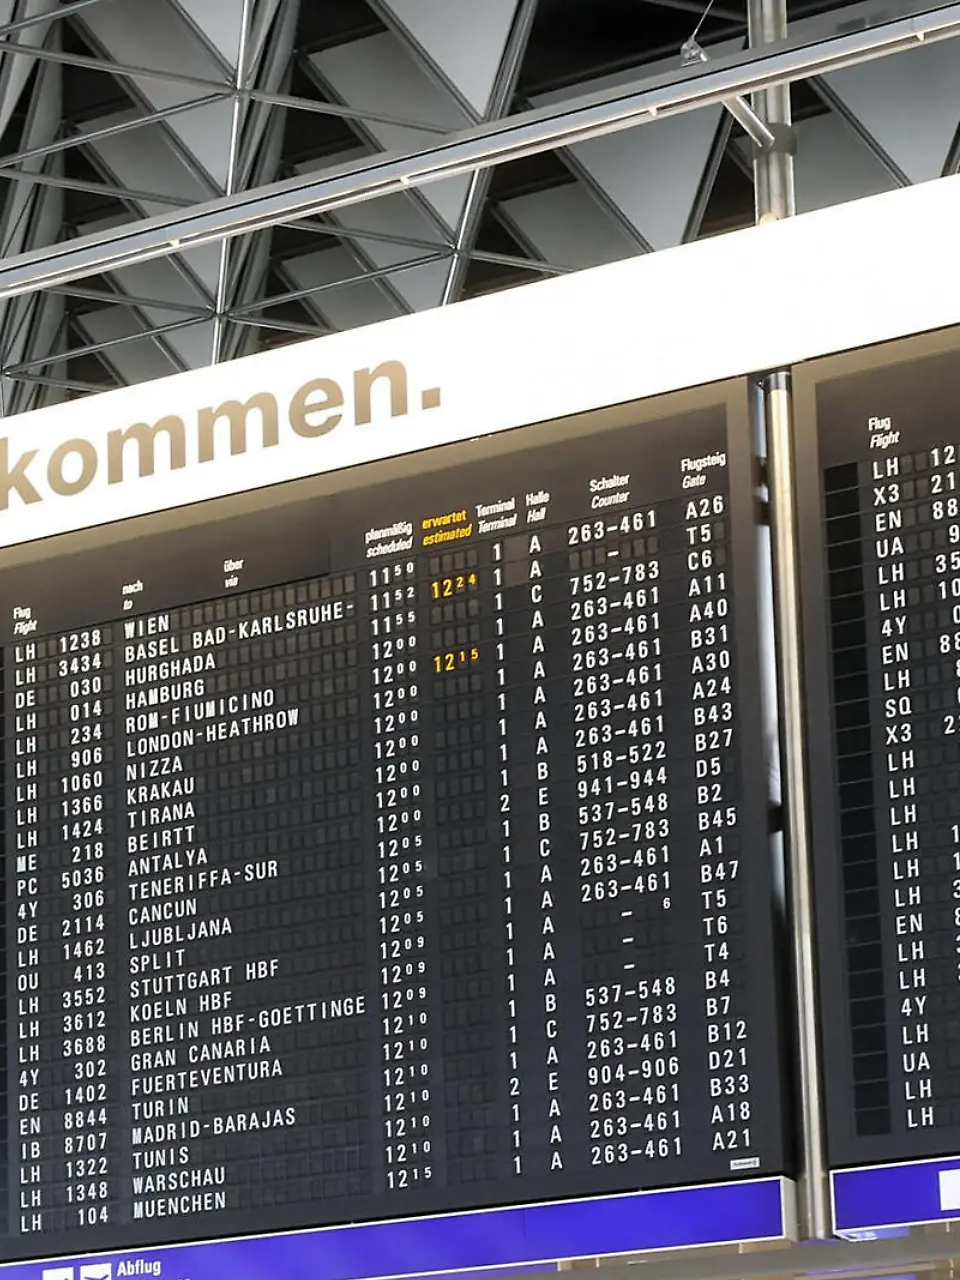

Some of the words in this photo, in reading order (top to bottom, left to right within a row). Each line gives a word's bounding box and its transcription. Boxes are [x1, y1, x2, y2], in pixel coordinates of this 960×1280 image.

[868, 416, 891, 431] Flug
[870, 431, 900, 449] Flight
[681, 452, 726, 472] Flugsteig
[872, 456, 899, 480] LH
[589, 474, 630, 492] Schalter
[682, 474, 706, 489] Gate
[476, 497, 515, 518] Terminal
[526, 490, 550, 507] Halle
[591, 491, 630, 509] Counter
[873, 483, 900, 507] X3
[422, 509, 467, 529] erwartet
[478, 513, 517, 534] Terminal
[527, 507, 547, 523] Hall
[875, 509, 902, 533] EN
[366, 536, 413, 558] scheduled
[423, 524, 472, 546] estimated
[59, 629, 101, 653] 1238
[124, 614, 169, 640] WIEN
[685, 495, 724, 520] A26
[13, 606, 31, 619] Flug
[125, 652, 216, 687] HURGHADA
[569, 560, 660, 596] 752-783
[881, 615, 907, 637] 4Y
[124, 636, 180, 663] BASEL
[125, 678, 205, 711] HAMBURG
[126, 707, 299, 758] LONDON-HEATHROW
[690, 624, 728, 649] B31
[125, 688, 274, 734] ROM-FIUMICINO
[884, 695, 913, 719] SQ
[126, 755, 183, 782] NIZZA
[126, 776, 195, 806] KRAKAU
[127, 801, 195, 829] TIRANA
[127, 847, 208, 877] ANTALYA
[577, 766, 667, 799] 941-944
[16, 853, 37, 873] ME
[61, 913, 105, 937] 2114
[128, 897, 197, 926] CANCUN
[698, 806, 737, 831] B45
[128, 859, 278, 901] TENERIFFA-SUR
[129, 916, 233, 950] LJUBLJANA
[129, 948, 185, 974] SPLIT
[130, 997, 187, 1023] KOELN
[199, 990, 232, 1013] HBF
[702, 915, 728, 936] T6
[130, 965, 233, 999] STUTTGART
[245, 958, 279, 981] HBF
[130, 1020, 199, 1047] BERLIN
[211, 995, 366, 1036] HBF-GOETTINGE
[130, 1048, 176, 1072] GRAN
[188, 1035, 271, 1064] CANARIA
[585, 976, 676, 1007] 537-548
[902, 1051, 931, 1073] UA
[131, 1058, 283, 1096] FUERTEVENTURA
[19, 1116, 41, 1136] EN
[64, 1107, 108, 1130] 8844
[131, 1096, 189, 1121] TURIN
[131, 1107, 296, 1145] MADRID-BARAJAS
[132, 1146, 189, 1170] TUNIS
[132, 1166, 225, 1195] WARSCHAU
[133, 1191, 226, 1219] MUENCHEN
[712, 1128, 750, 1151] A21
[117, 1260, 161, 1276] Abflug
